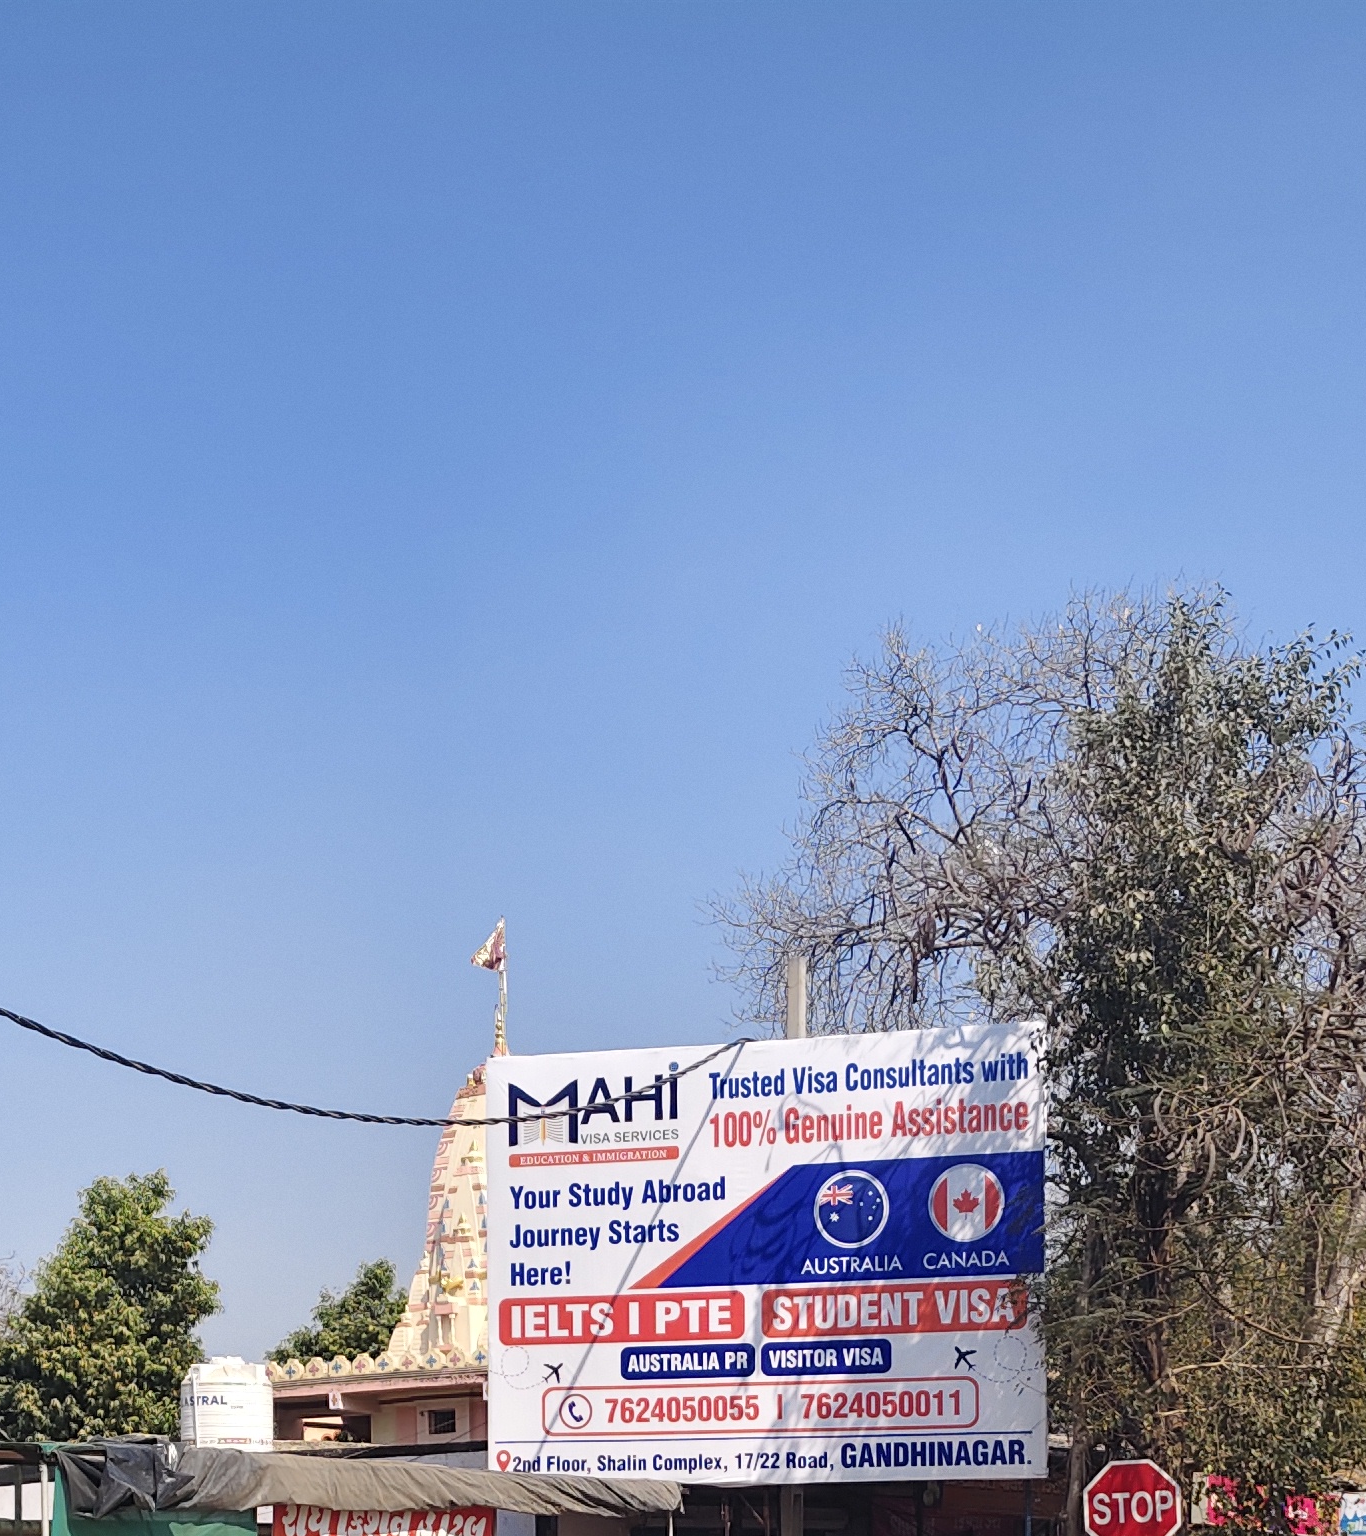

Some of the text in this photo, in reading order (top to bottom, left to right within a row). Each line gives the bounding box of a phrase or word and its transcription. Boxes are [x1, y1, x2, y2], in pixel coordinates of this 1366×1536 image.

[708, 1052, 1029, 1100] Trusted Visa Consultants with
[580, 1129, 679, 1145] VISA SERVICES
[709, 1098, 1029, 1148] 100% Genuine Assistance
[519, 1149, 667, 1166] EDUCATION & IMMIGRATION
[509, 1175, 726, 1211] Your Study Abroad
[509, 1219, 680, 1251] Journey Starts
[510, 1260, 572, 1287] Here!
[800, 1254, 903, 1275] AUSTRALIA
[922, 1250, 1010, 1270] CANADA
[510, 1301, 615, 1339] IELTS
[654, 1298, 732, 1335] PTE
[772, 1287, 1015, 1331] STUDENT VISA
[627, 1351, 748, 1373] AUSTRALIA PR
[768, 1347, 884, 1369] VISITOR VISA
[184, 1395, 228, 1407] ASTRAL
[604, 1394, 760, 1424] 7624050055
[800, 1389, 961, 1420] 7624050011
[512, 1439, 1032, 1475] 2nd Floor, Shalin Complex, 17/22 Road, GANDHINAGAR.
[1092, 1489, 1174, 1526] STOP
